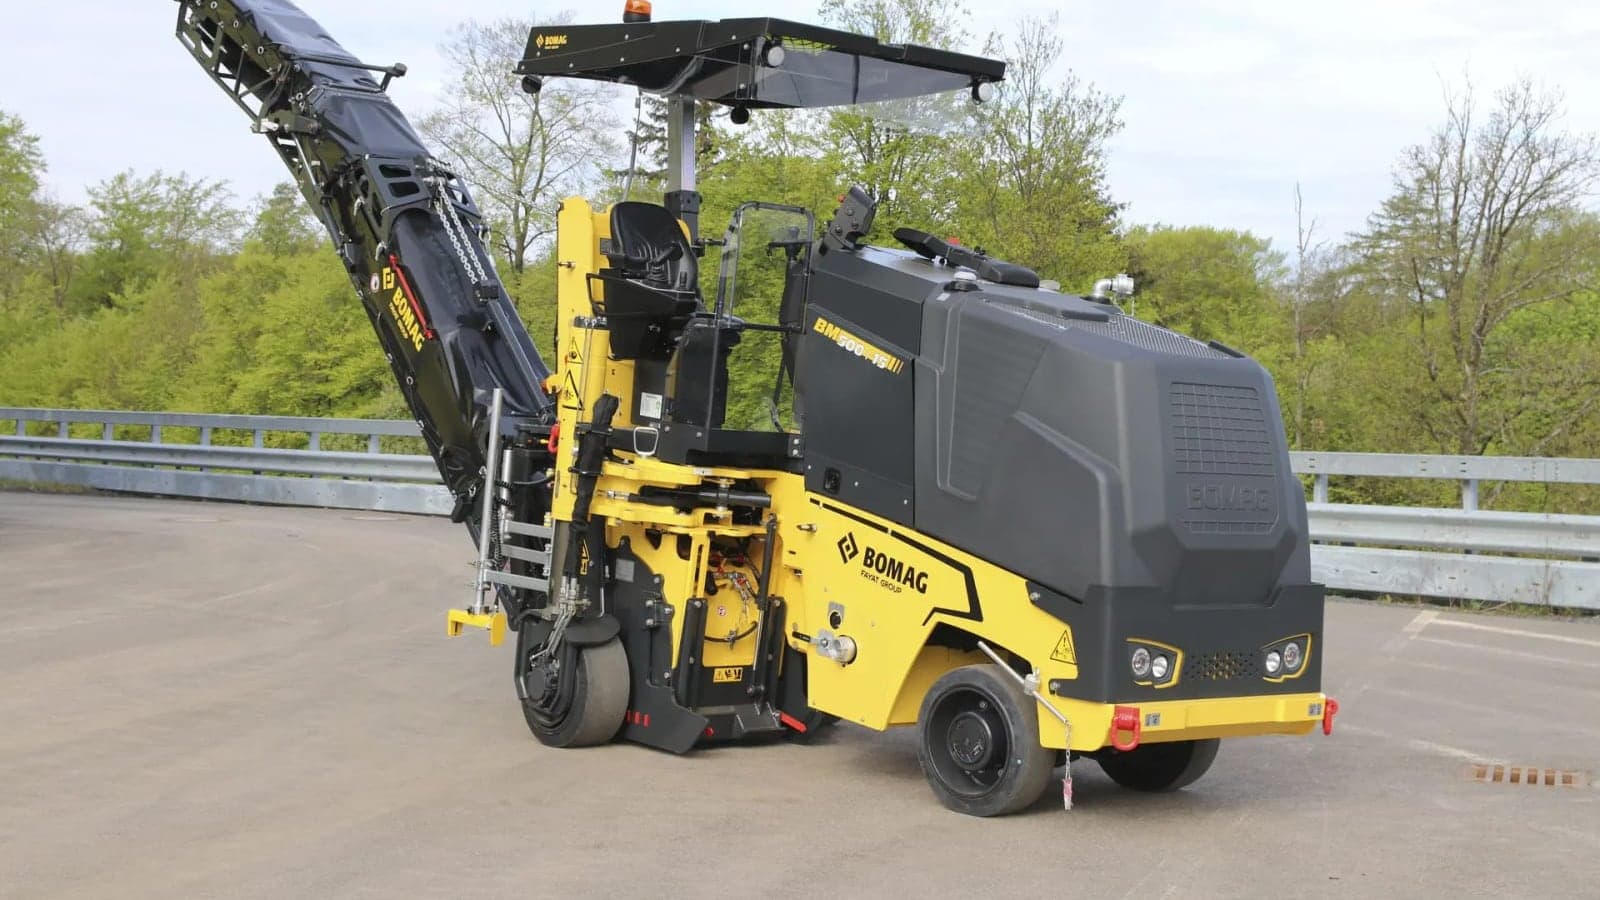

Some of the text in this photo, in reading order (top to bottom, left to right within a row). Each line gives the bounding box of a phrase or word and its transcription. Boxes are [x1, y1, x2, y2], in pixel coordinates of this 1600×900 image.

[545, 35, 567, 45] BOMAG
[393, 287, 425, 352] BOMAG
[860, 569, 902, 593] FAYAT GROUP
[863, 546, 928, 594] BOMAG
